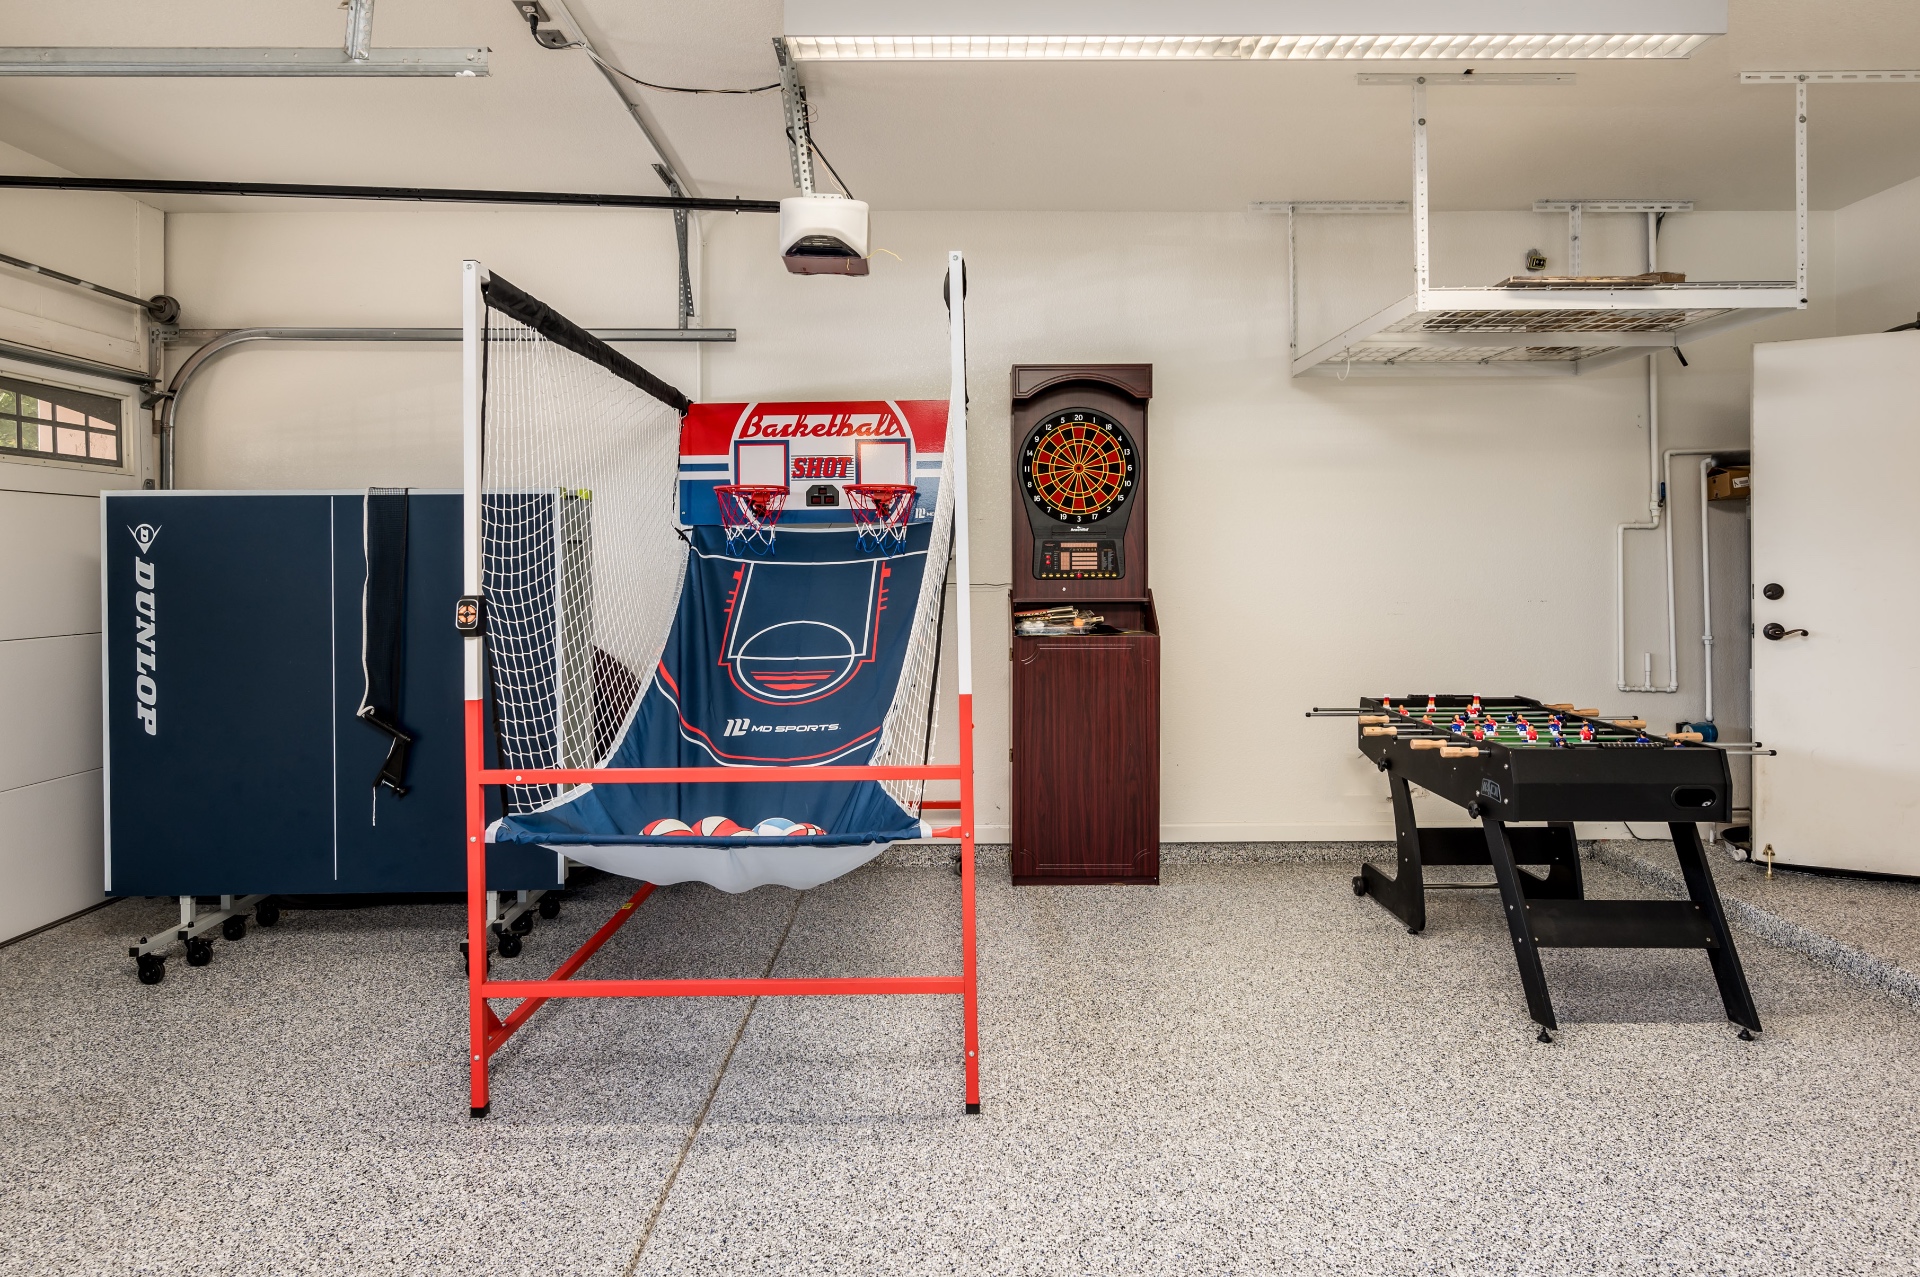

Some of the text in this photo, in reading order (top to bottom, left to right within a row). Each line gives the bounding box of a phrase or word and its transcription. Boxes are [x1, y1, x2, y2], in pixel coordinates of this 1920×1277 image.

[744, 414, 904, 438] Basketball
[791, 457, 853, 479] SHOT
[135, 556, 157, 736] DUNLOP
[751, 723, 840, 733] MD SPORTS
